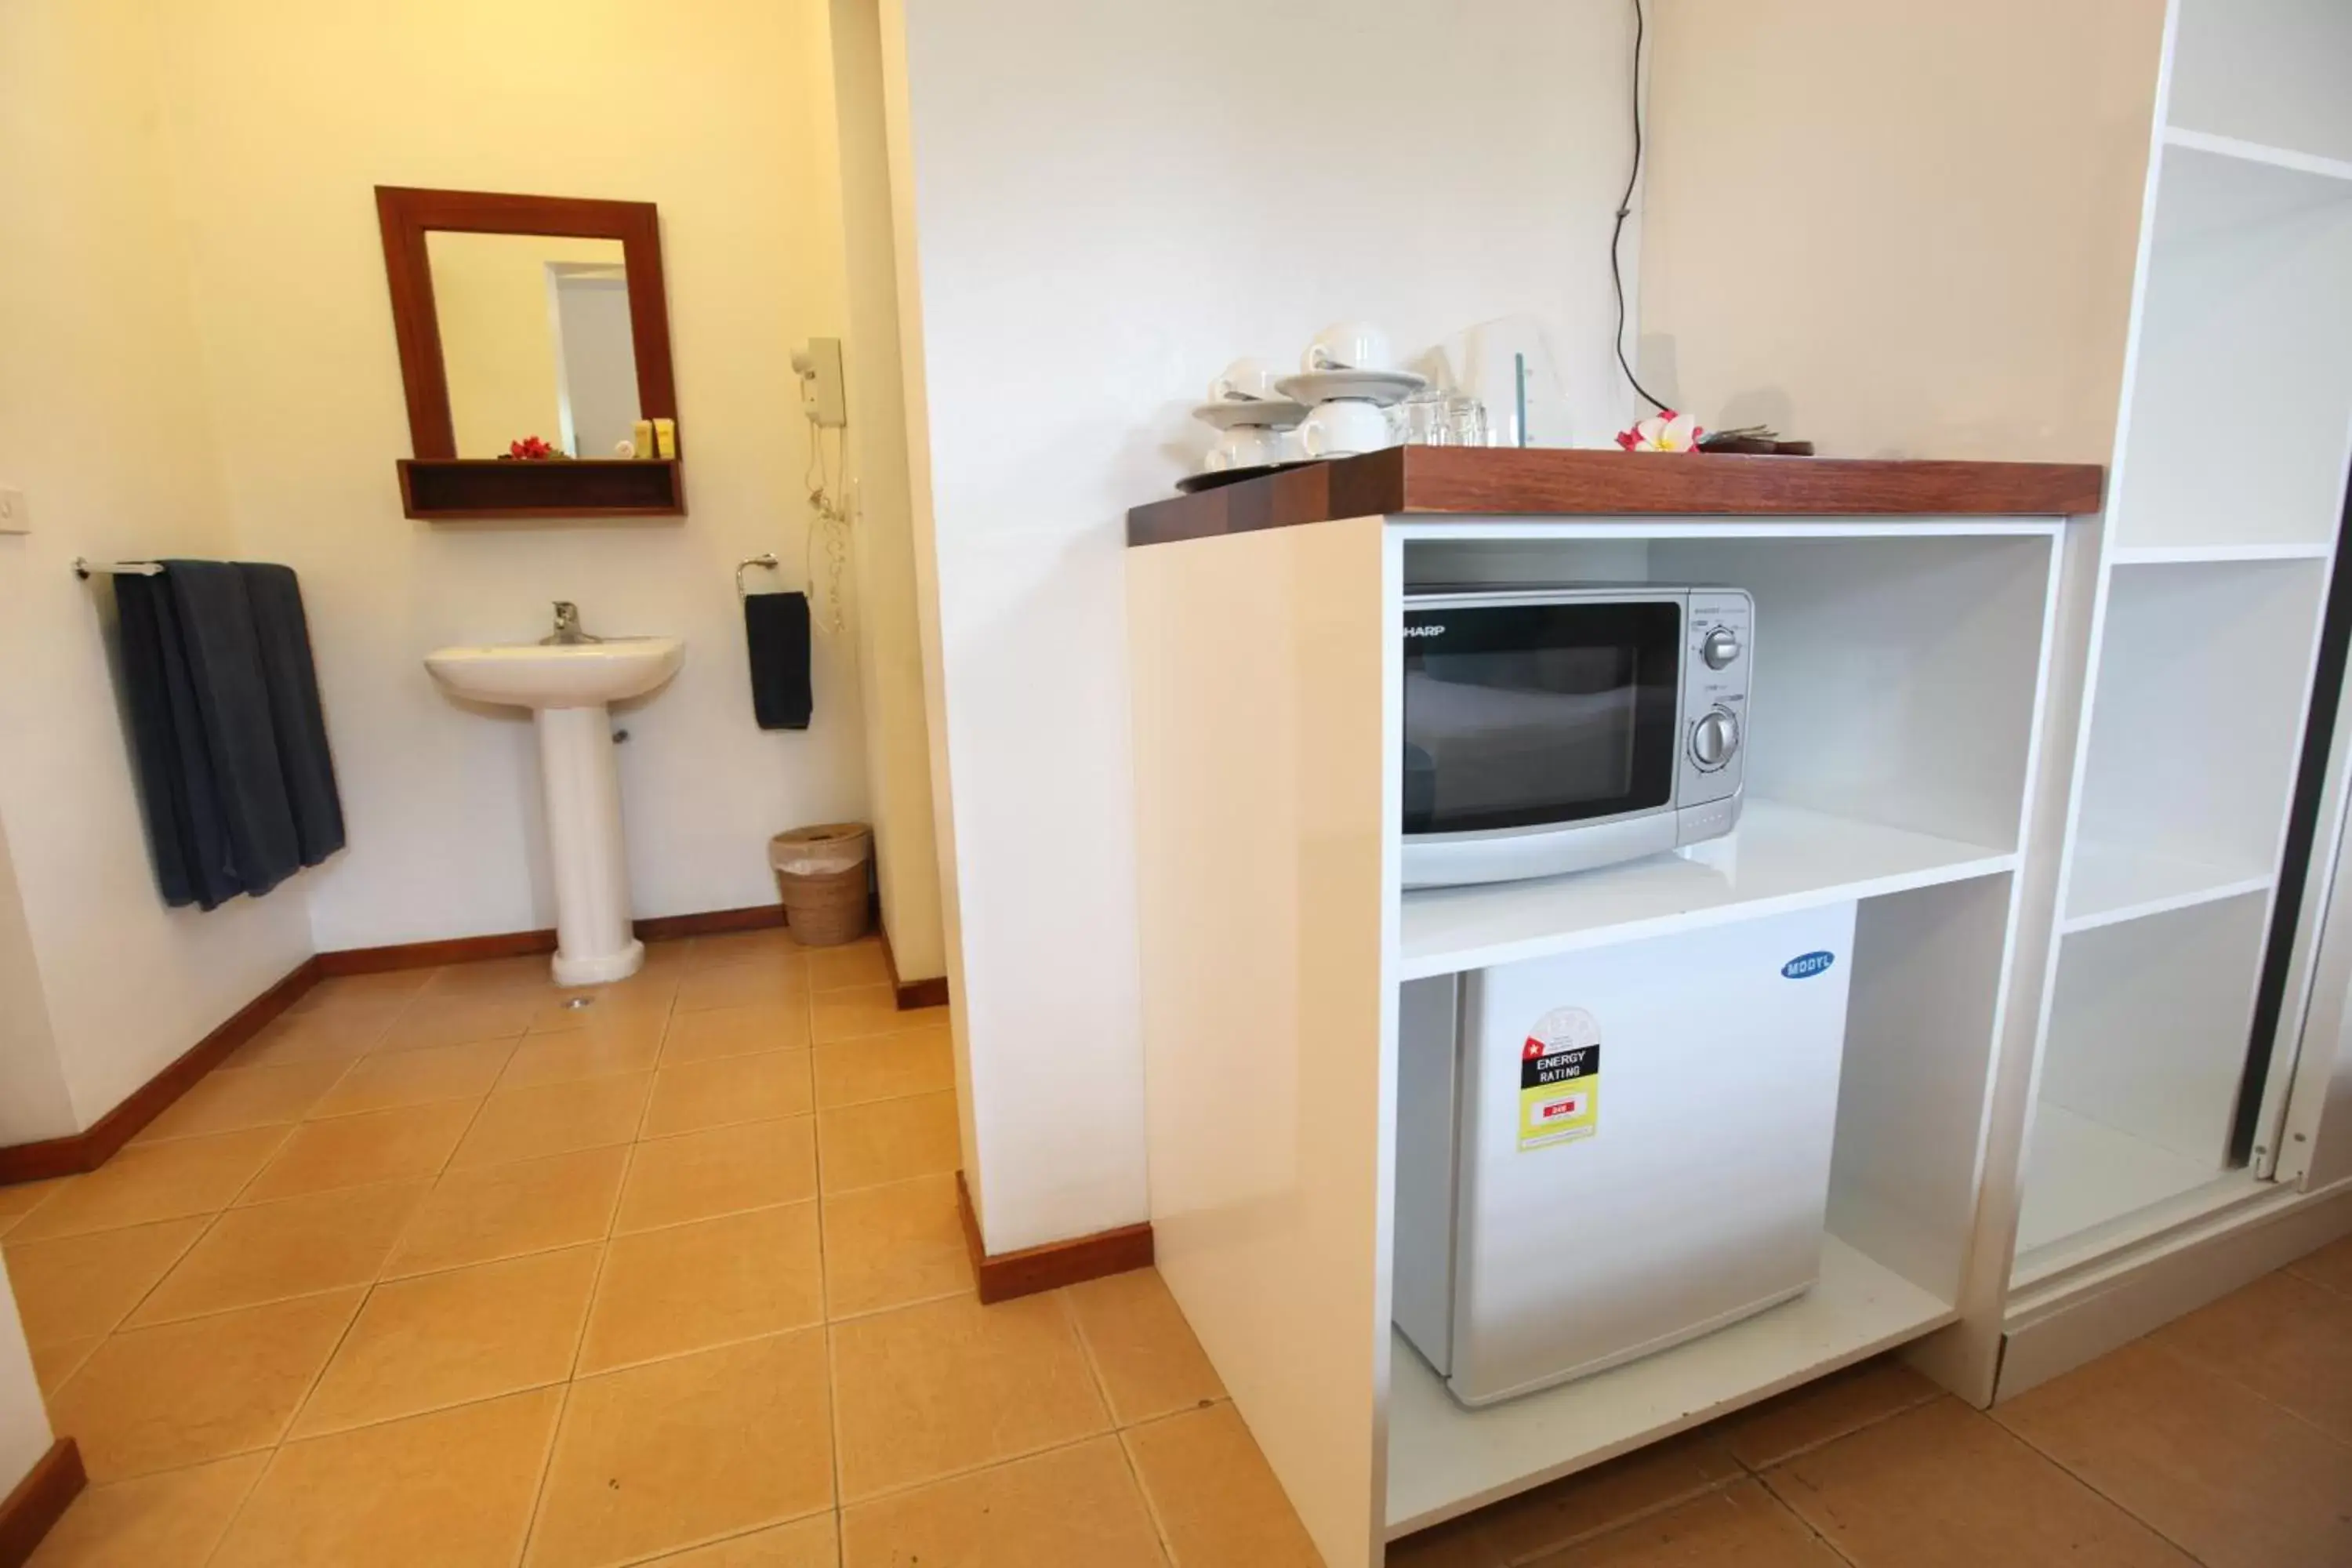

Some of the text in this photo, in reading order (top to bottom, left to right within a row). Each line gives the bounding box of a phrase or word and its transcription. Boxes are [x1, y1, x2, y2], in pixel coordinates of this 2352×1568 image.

[1403, 626, 1446, 637] HARP
[1537, 1051, 1586, 1070] ENERGY
[1540, 1065, 1581, 1083] RATING
